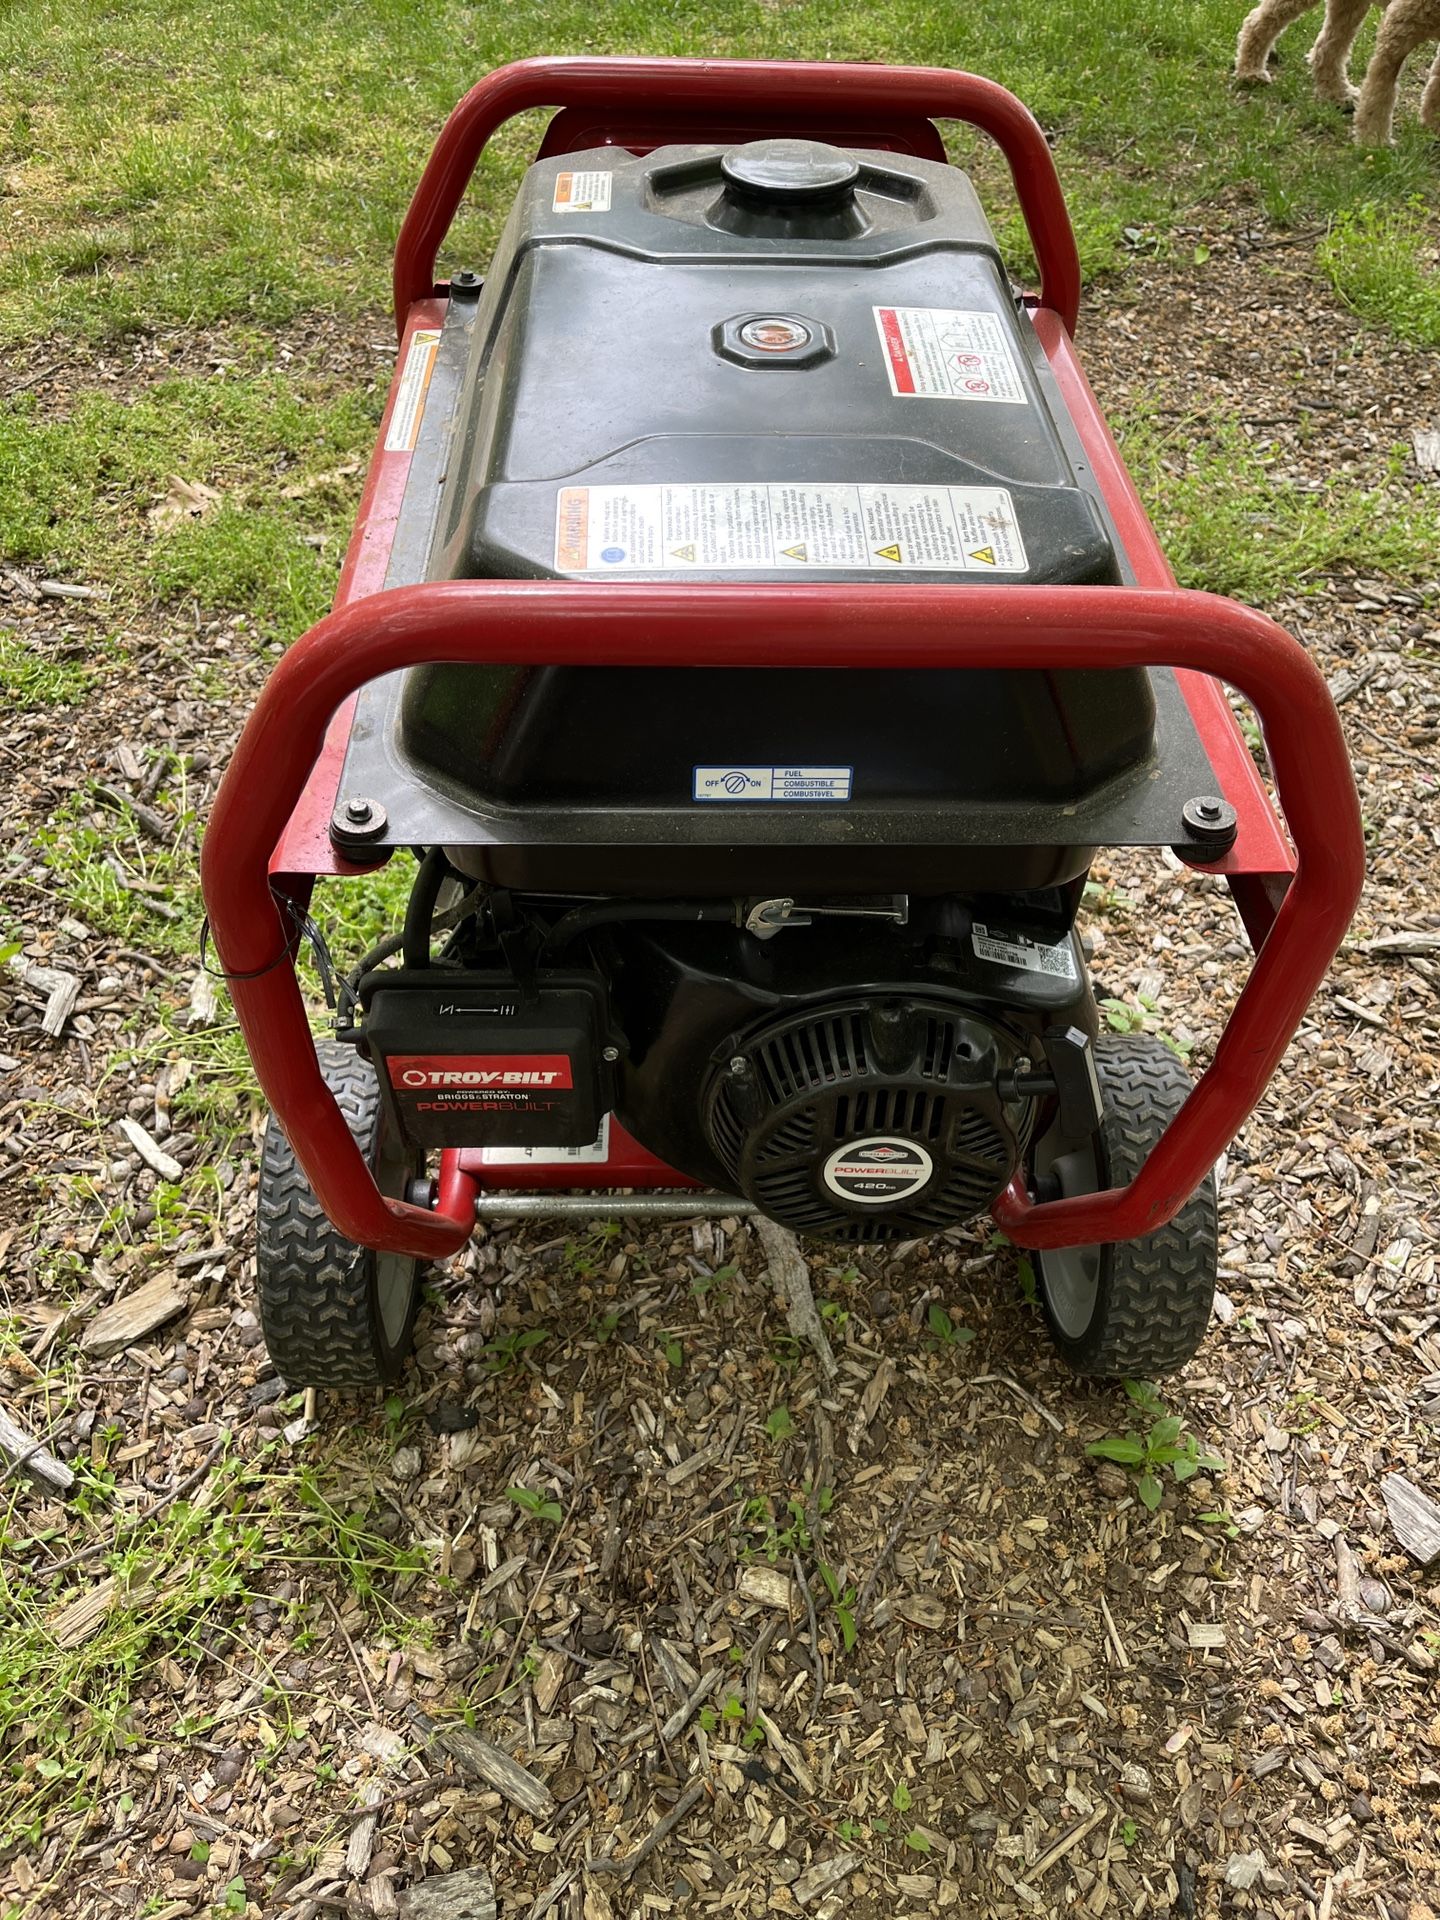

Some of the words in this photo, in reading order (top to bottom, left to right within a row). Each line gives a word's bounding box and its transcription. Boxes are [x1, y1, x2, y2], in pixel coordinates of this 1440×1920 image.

[891, 337, 902, 357] DANGER
[566, 499, 581, 548] WARNING
[416, 1101, 556, 1112] POWERBUILT
[833, 1166, 922, 1176] POWERBUILT
